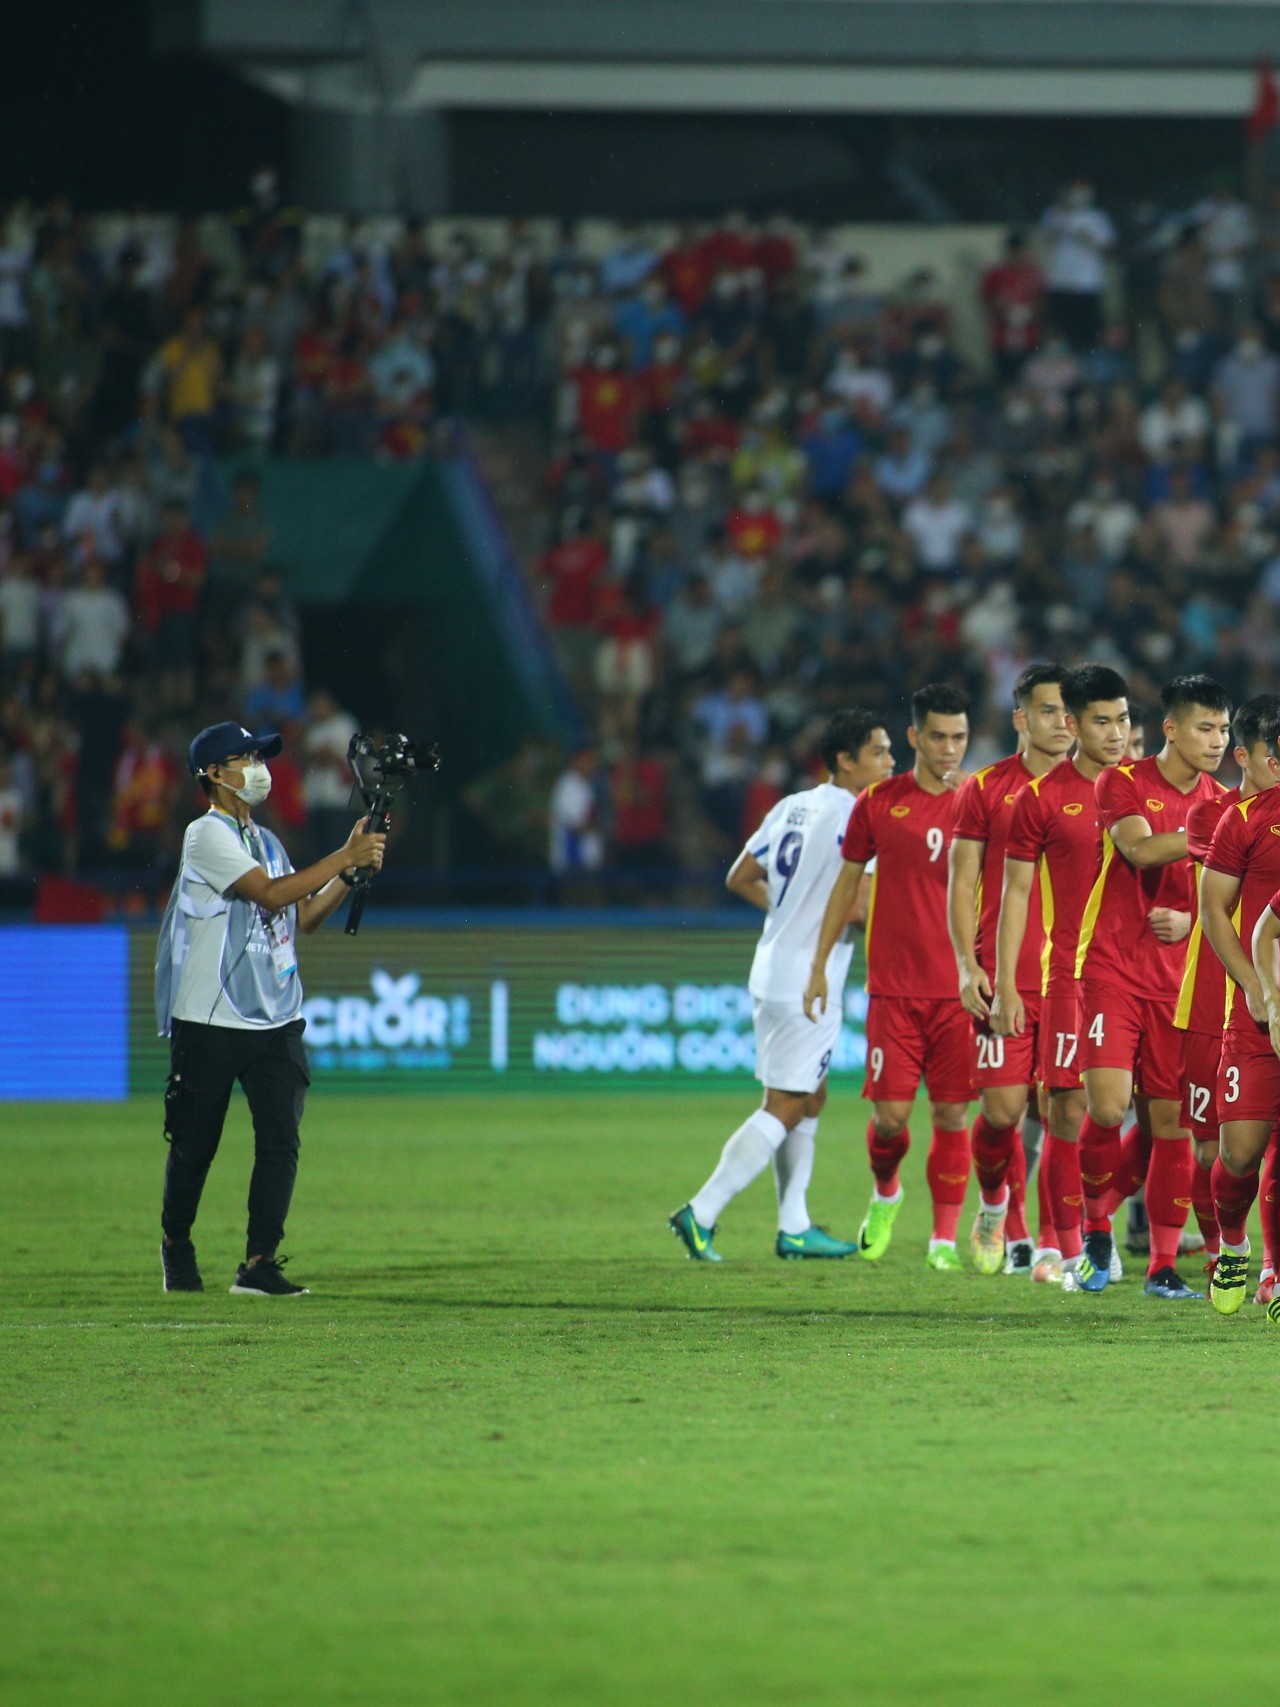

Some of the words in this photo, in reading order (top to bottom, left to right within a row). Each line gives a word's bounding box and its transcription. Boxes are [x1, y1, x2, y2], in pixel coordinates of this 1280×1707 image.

[926, 827, 944, 862] 9
[776, 831, 804, 908] 9
[1088, 1013, 1105, 1047] 4
[816, 1049, 832, 1079] 9
[871, 1046, 884, 1082] 9
[976, 1033, 1005, 1069] 20
[1055, 1032, 1078, 1068] 17
[1189, 1082, 1211, 1123] 12
[1224, 1066, 1240, 1103] 3
